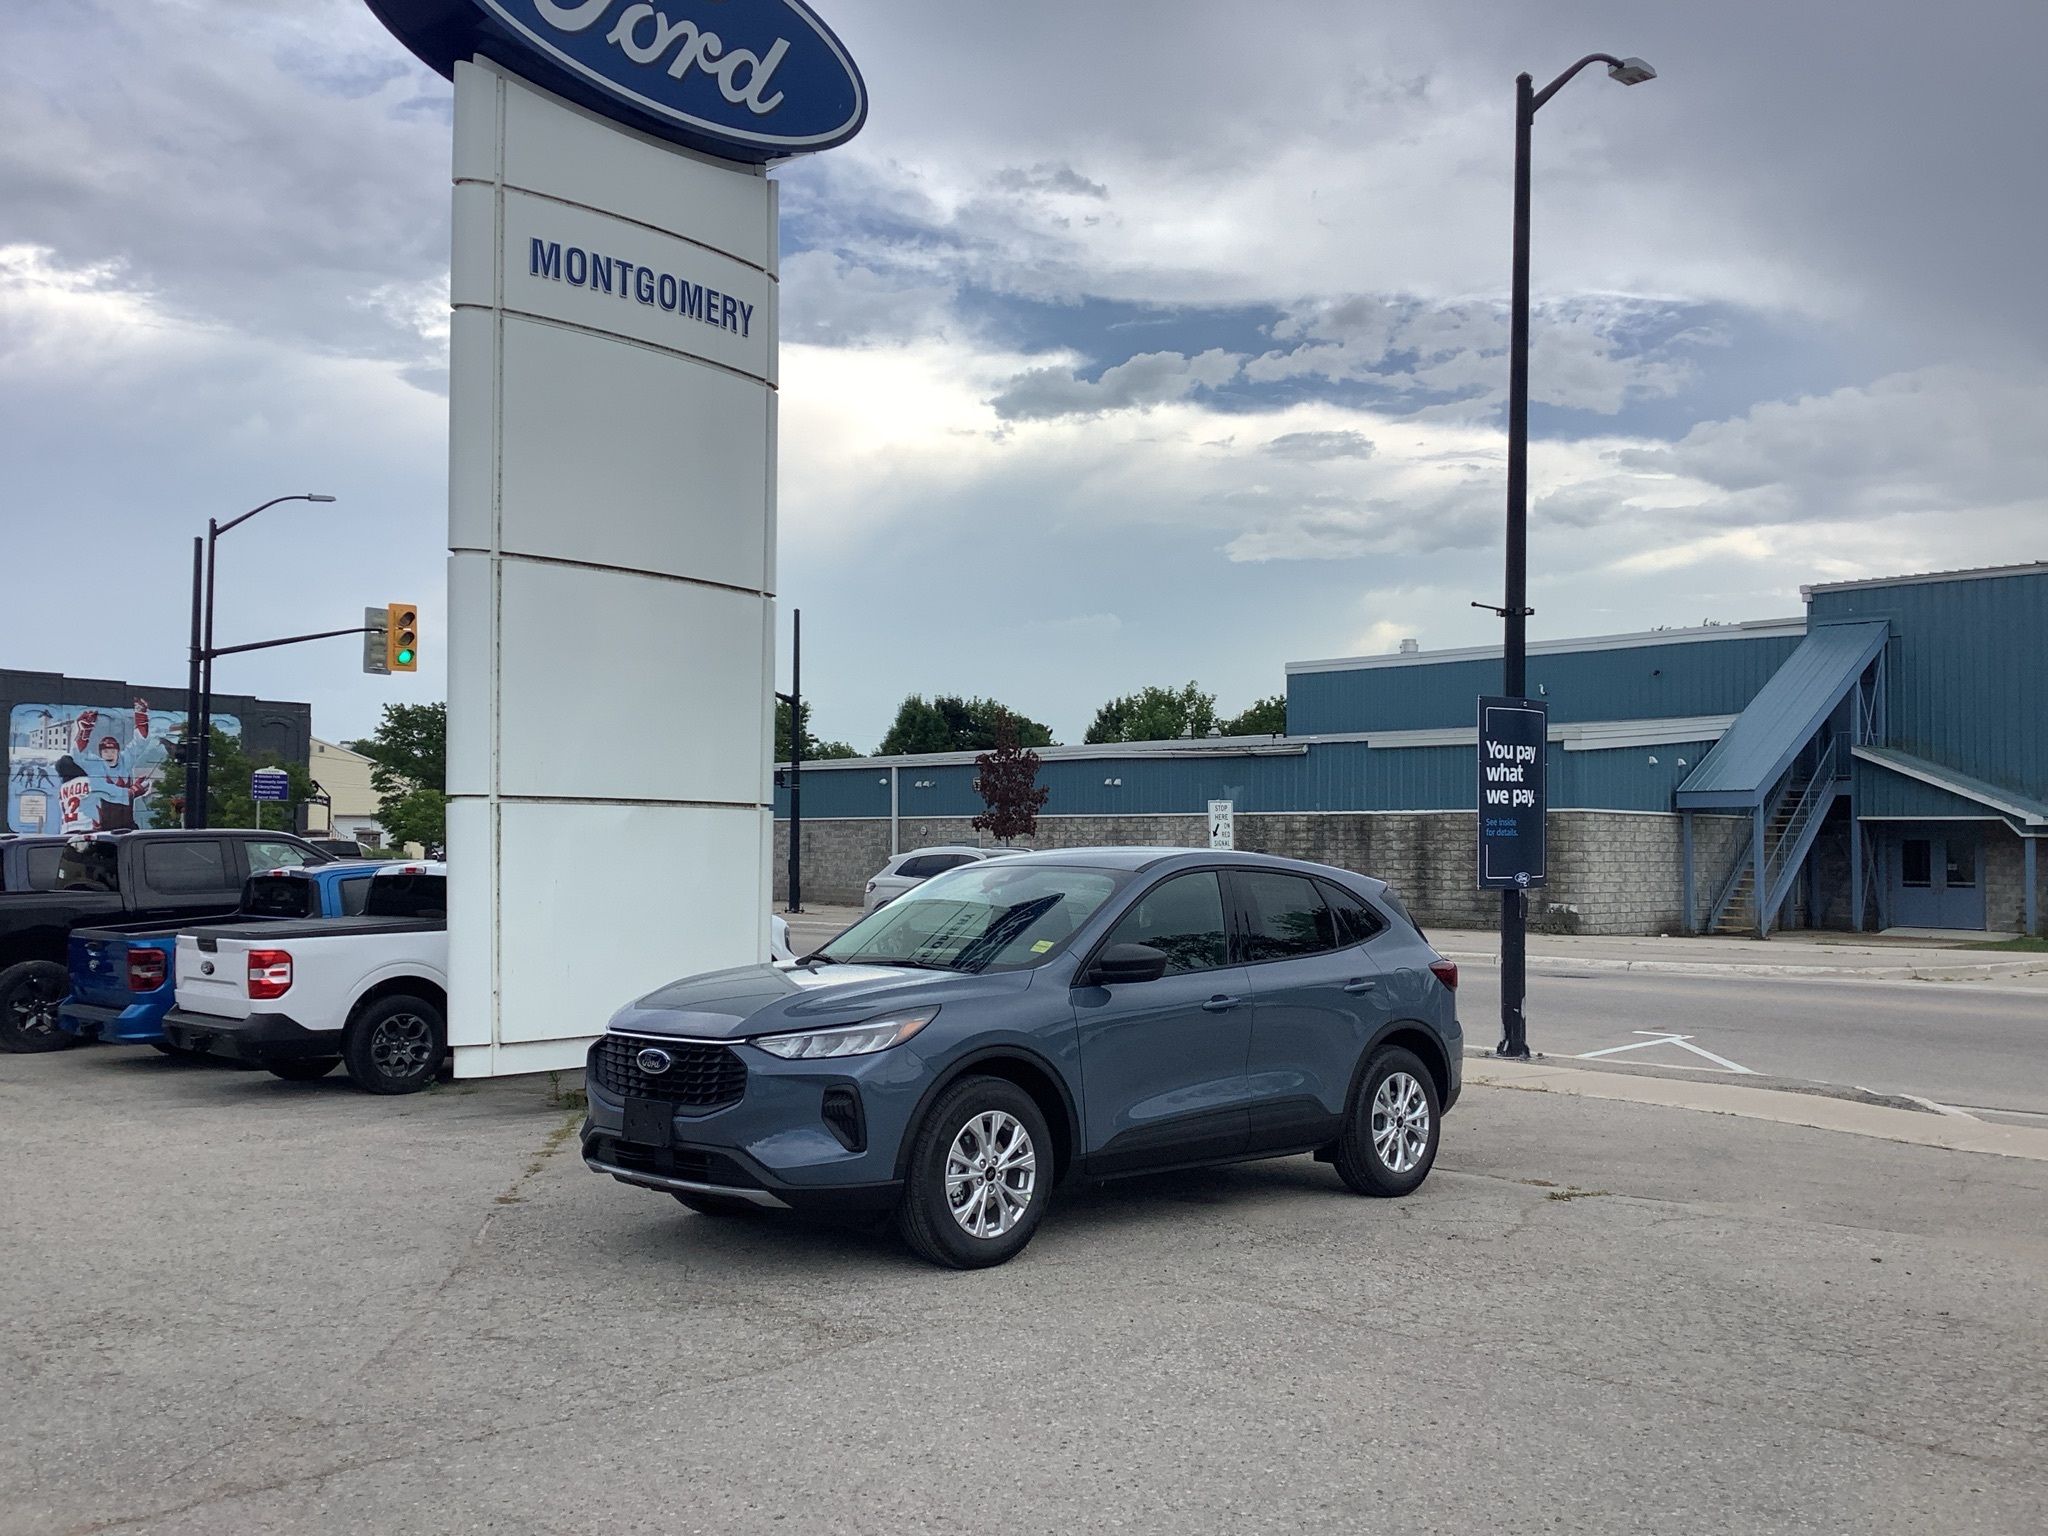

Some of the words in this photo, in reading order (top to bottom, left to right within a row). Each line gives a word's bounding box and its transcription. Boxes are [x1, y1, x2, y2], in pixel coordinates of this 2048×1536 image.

[530, 237, 753, 337] MONTGOMERY
[1486, 740, 1513, 759] You
[1516, 745, 1536, 764] pay
[1486, 762, 1523, 782] what
[1486, 789, 1509, 804] we
[1512, 789, 1535, 808] pay.
[1486, 818, 1497, 826] See
[1499, 818, 1516, 826] inside
[1486, 828, 1495, 836] for
[1496, 828, 1518, 836] details.
